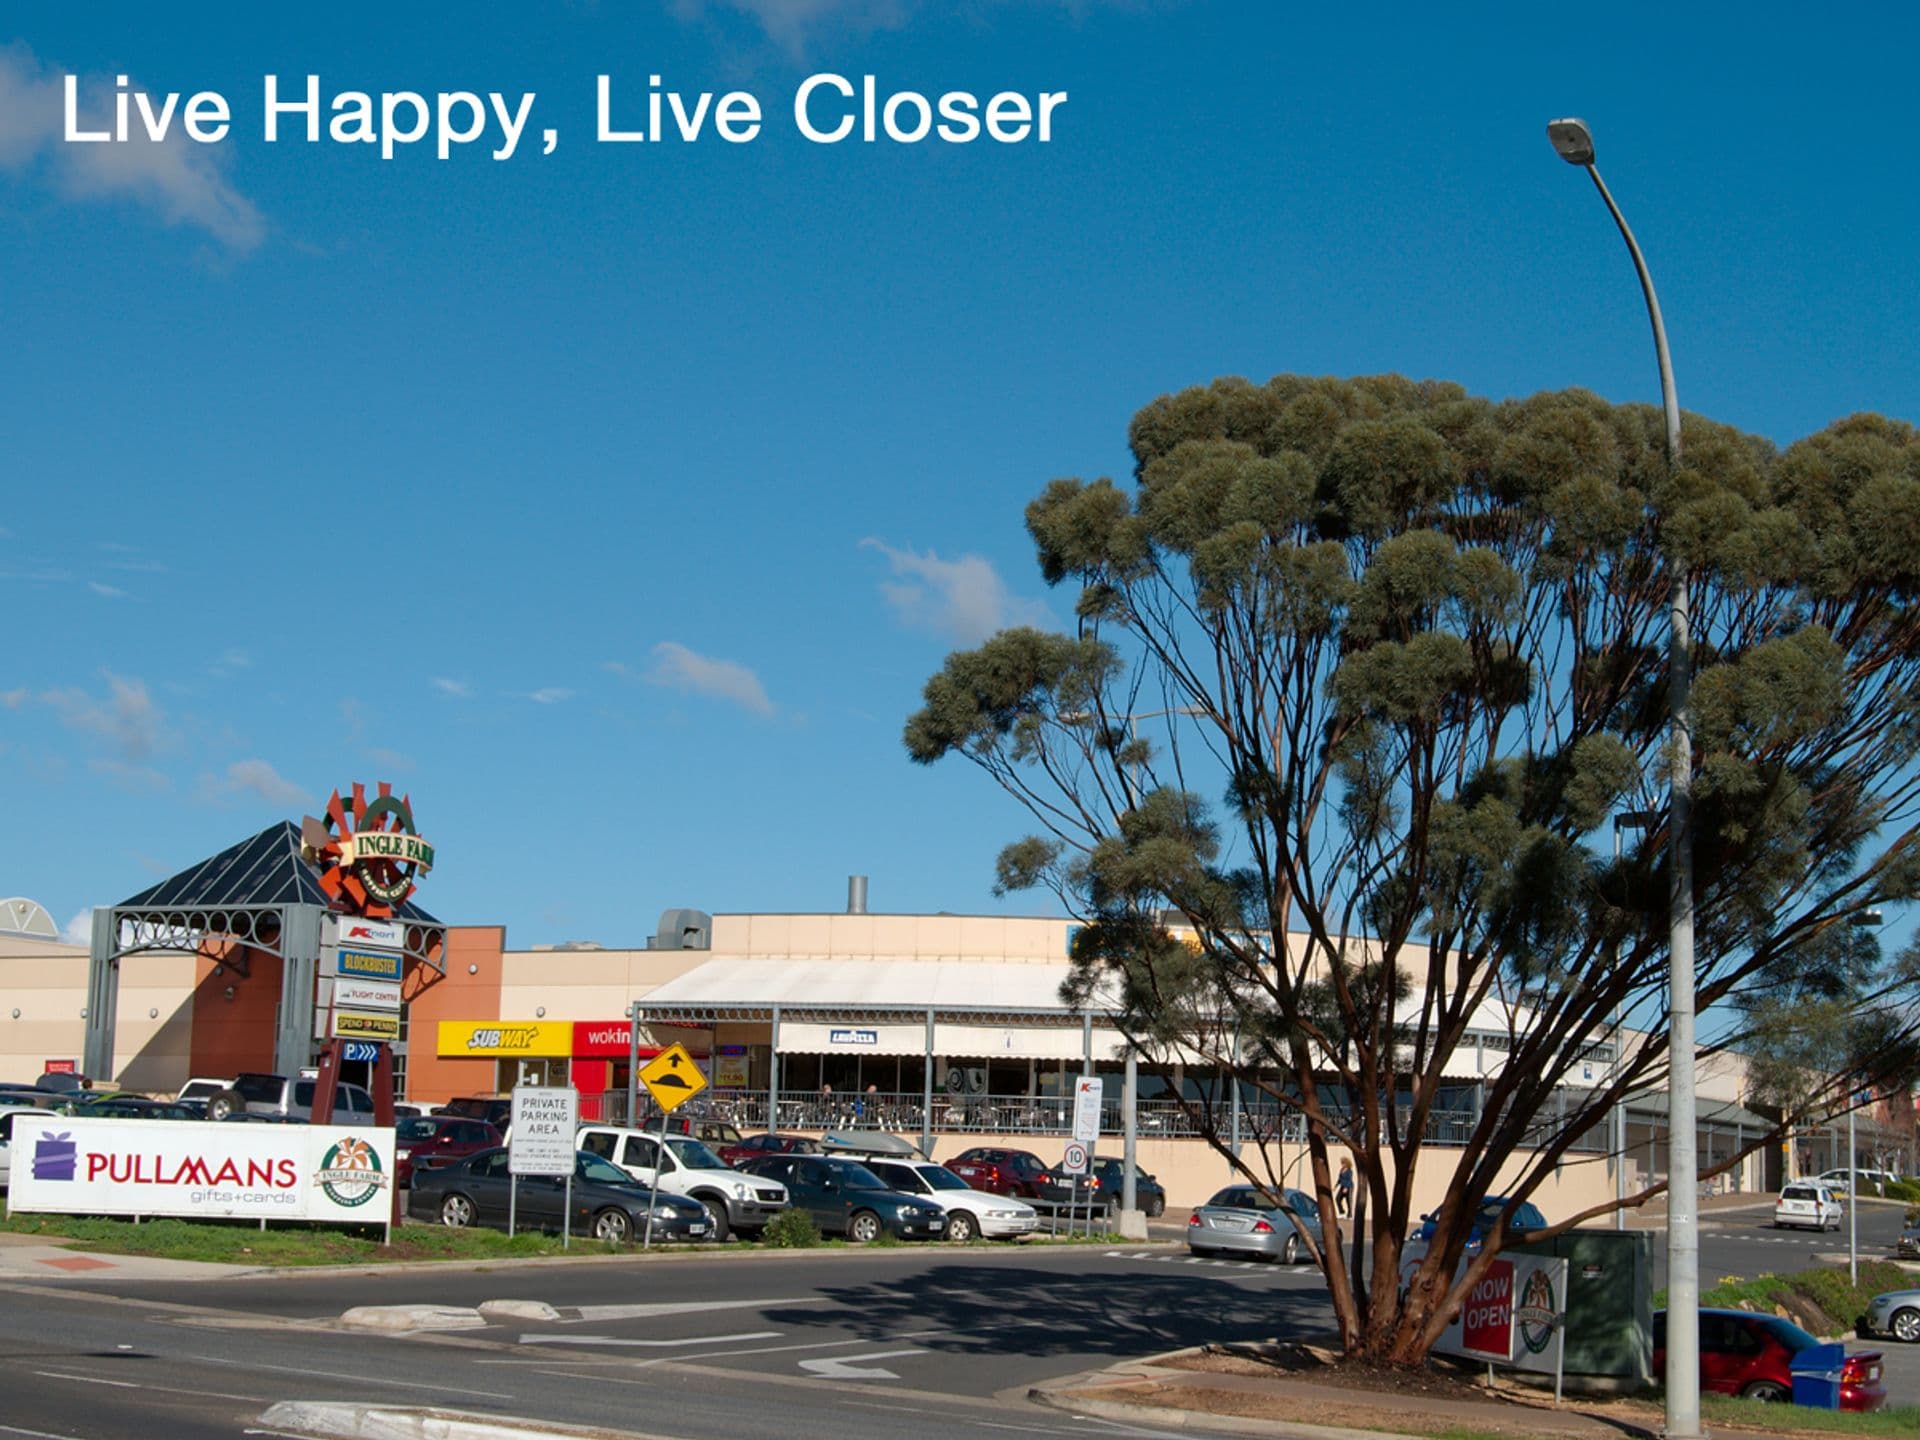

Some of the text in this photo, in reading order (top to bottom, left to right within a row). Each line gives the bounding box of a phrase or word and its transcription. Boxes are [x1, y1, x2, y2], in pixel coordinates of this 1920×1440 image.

[357, 835, 402, 856] INGLE
[344, 953, 397, 974] BLOCKBUSTER
[351, 989, 374, 999] FLIGHT
[375, 992, 399, 1002] CENTRE
[467, 1026, 540, 1050] SUBWAY
[522, 1098, 568, 1109] PRIVATE
[520, 1110, 568, 1122] PARKING
[528, 1124, 560, 1135] AREA
[1069, 1150, 1083, 1163] 10
[87, 1152, 298, 1189] PULLMANS
[322, 1170, 380, 1182] INGLE FARM
[190, 1188, 297, 1205] gifts+cards
[1471, 1276, 1510, 1301] NOW
[1467, 1304, 1510, 1330] OPEN
